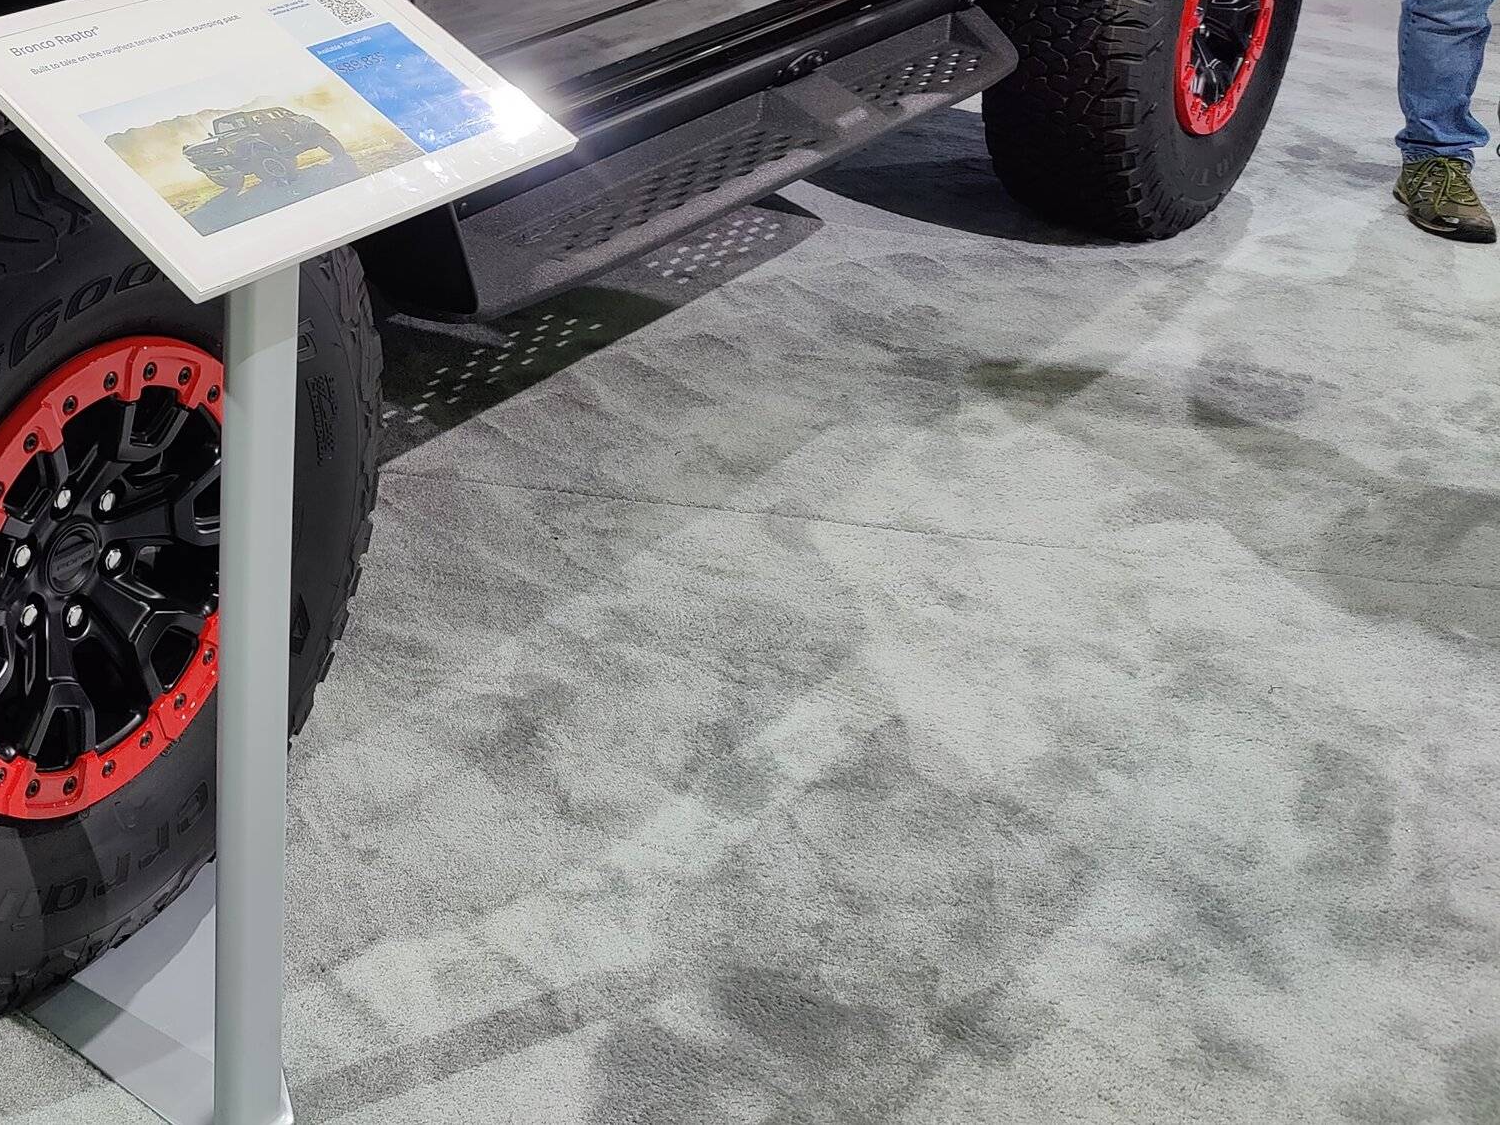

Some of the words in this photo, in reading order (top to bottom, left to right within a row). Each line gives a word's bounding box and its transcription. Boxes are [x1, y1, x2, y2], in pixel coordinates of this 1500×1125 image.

[9, 39, 56, 56] Bronco
[29, 64, 51, 75] Built
[59, 58, 77, 66] take
